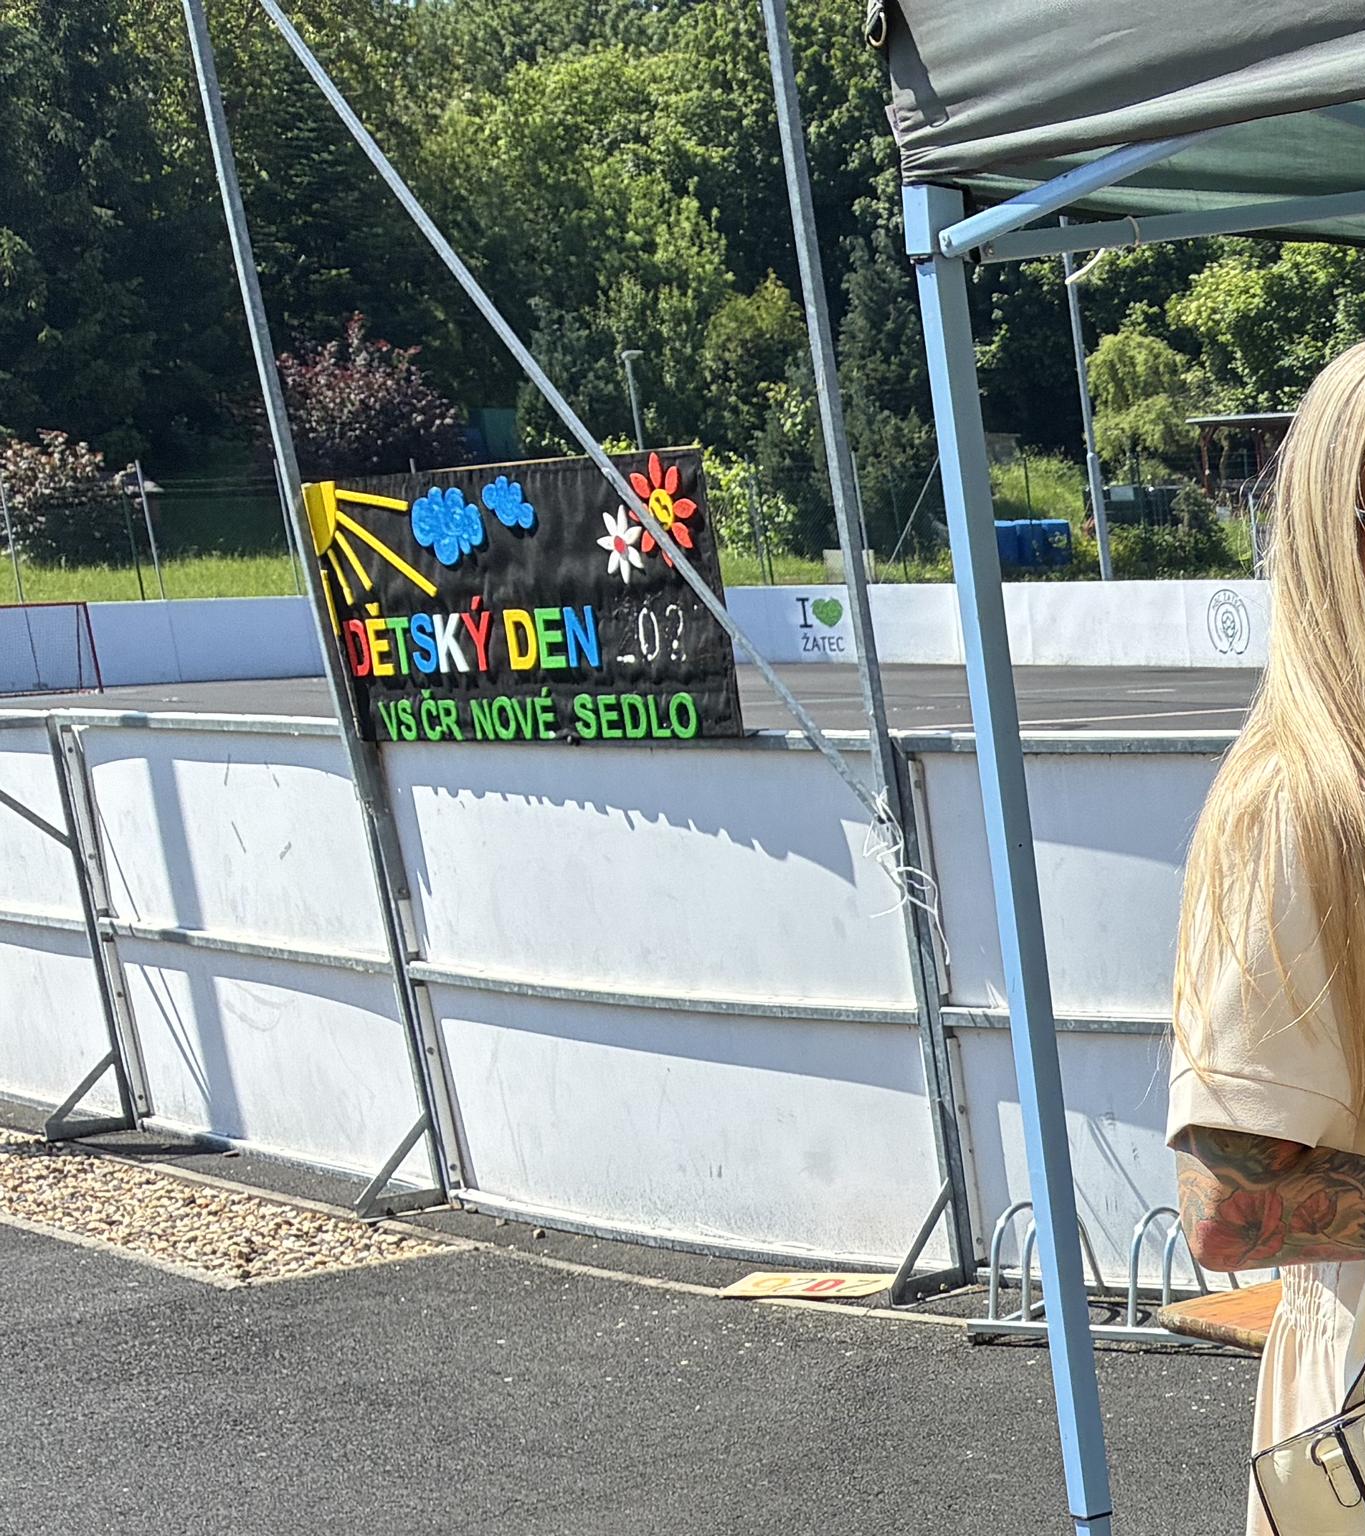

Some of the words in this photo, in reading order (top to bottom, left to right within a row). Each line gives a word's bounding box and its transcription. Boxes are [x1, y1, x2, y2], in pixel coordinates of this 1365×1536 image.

[796, 597, 813, 629] I
[343, 595, 491, 677] DĚTSKÝ
[503, 605, 600, 671] DEN
[801, 633, 845, 652] ŽATEC
[471, 687, 557, 740] NOVÉ
[574, 692, 698, 739] SEDLO
